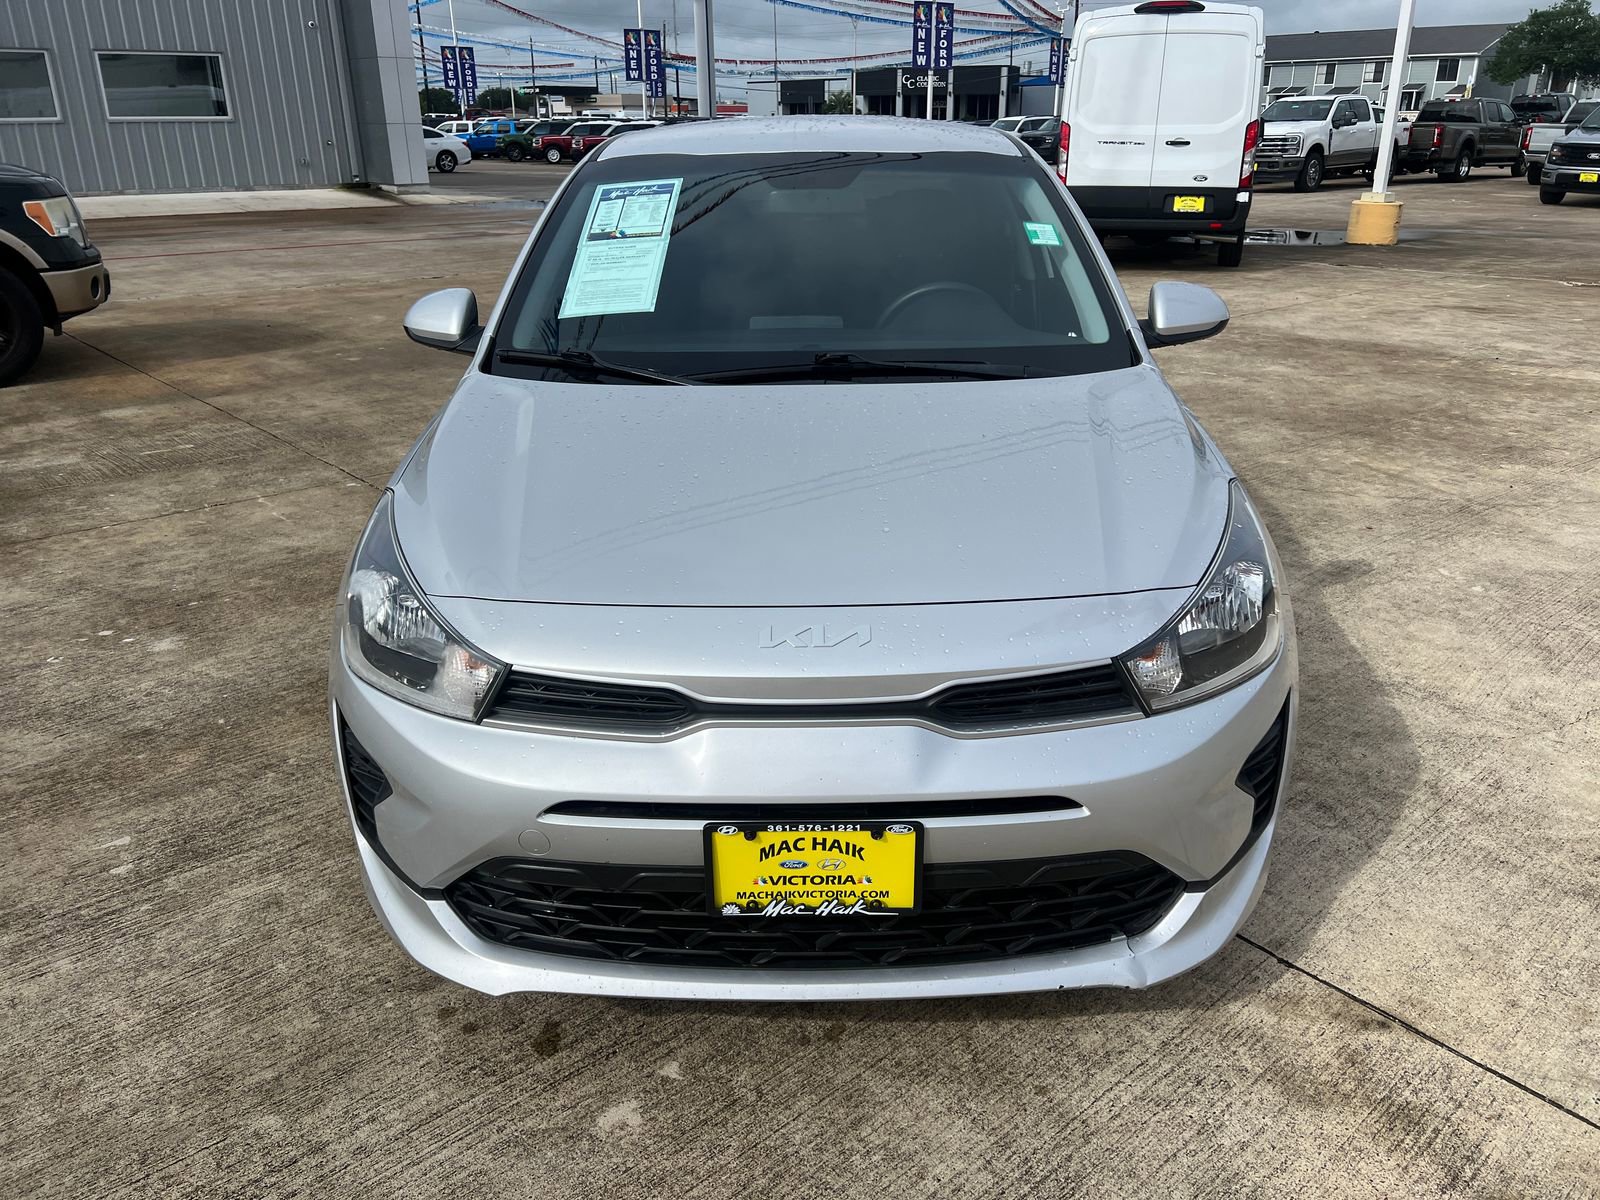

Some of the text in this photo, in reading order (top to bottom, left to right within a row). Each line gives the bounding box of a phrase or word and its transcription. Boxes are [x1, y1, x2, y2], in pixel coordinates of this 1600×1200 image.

[916, 28, 926, 66] NEW
[939, 30, 947, 67] FORD
[446, 62, 456, 87] NEW
[465, 63, 473, 87] FORD
[629, 50, 639, 79] NEW
[650, 51, 658, 80] FORD
[767, 824, 861, 832] 361-576-1221
[759, 837, 865, 863] MAC HAIK
[782, 861, 804, 869] Ford
[768, 875, 857, 886] VICTORIA
[736, 890, 890, 900] MACHAIKVICTORIA.COM
[761, 899, 868, 917] Mac Haik
